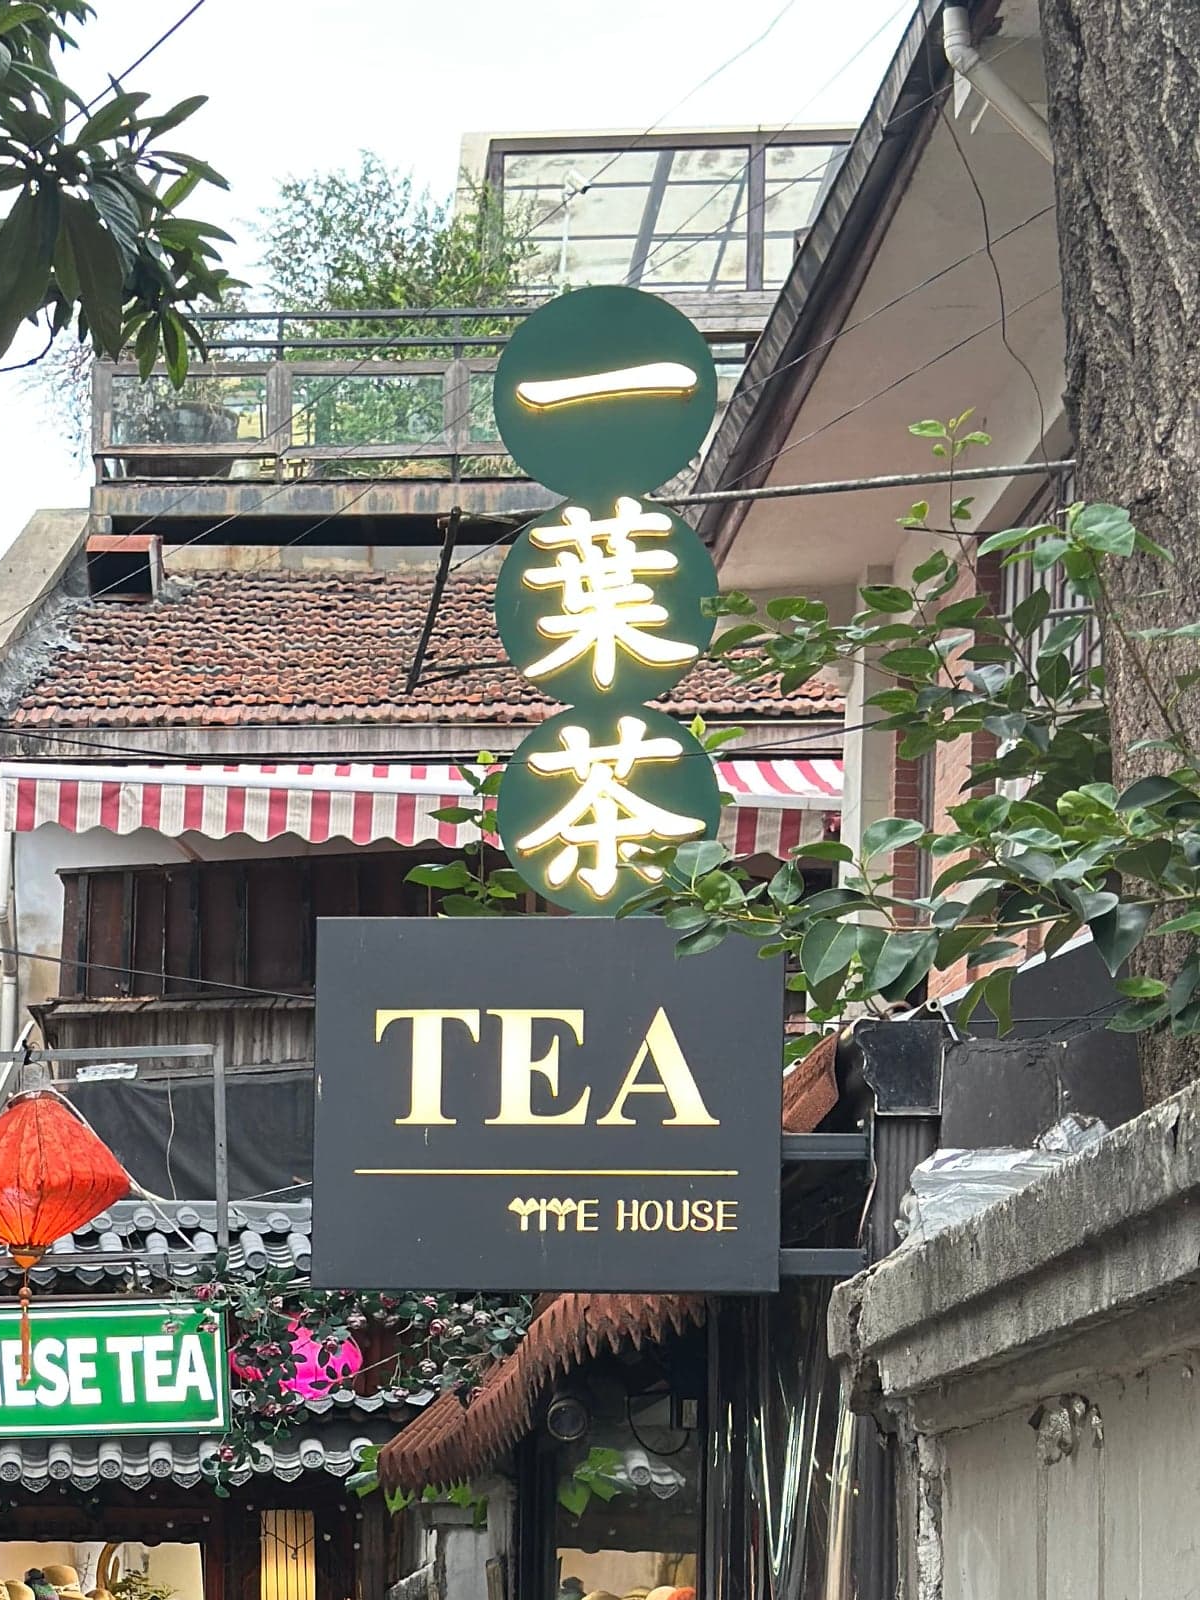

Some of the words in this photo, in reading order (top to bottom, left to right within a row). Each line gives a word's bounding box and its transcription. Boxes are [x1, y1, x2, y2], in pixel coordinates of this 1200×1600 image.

[516, 362, 707, 900] 一葉茶
[375, 1006, 721, 1127] TEA
[615, 1198, 739, 1232] HOUSE
[105, 1334, 215, 1404] TEA
